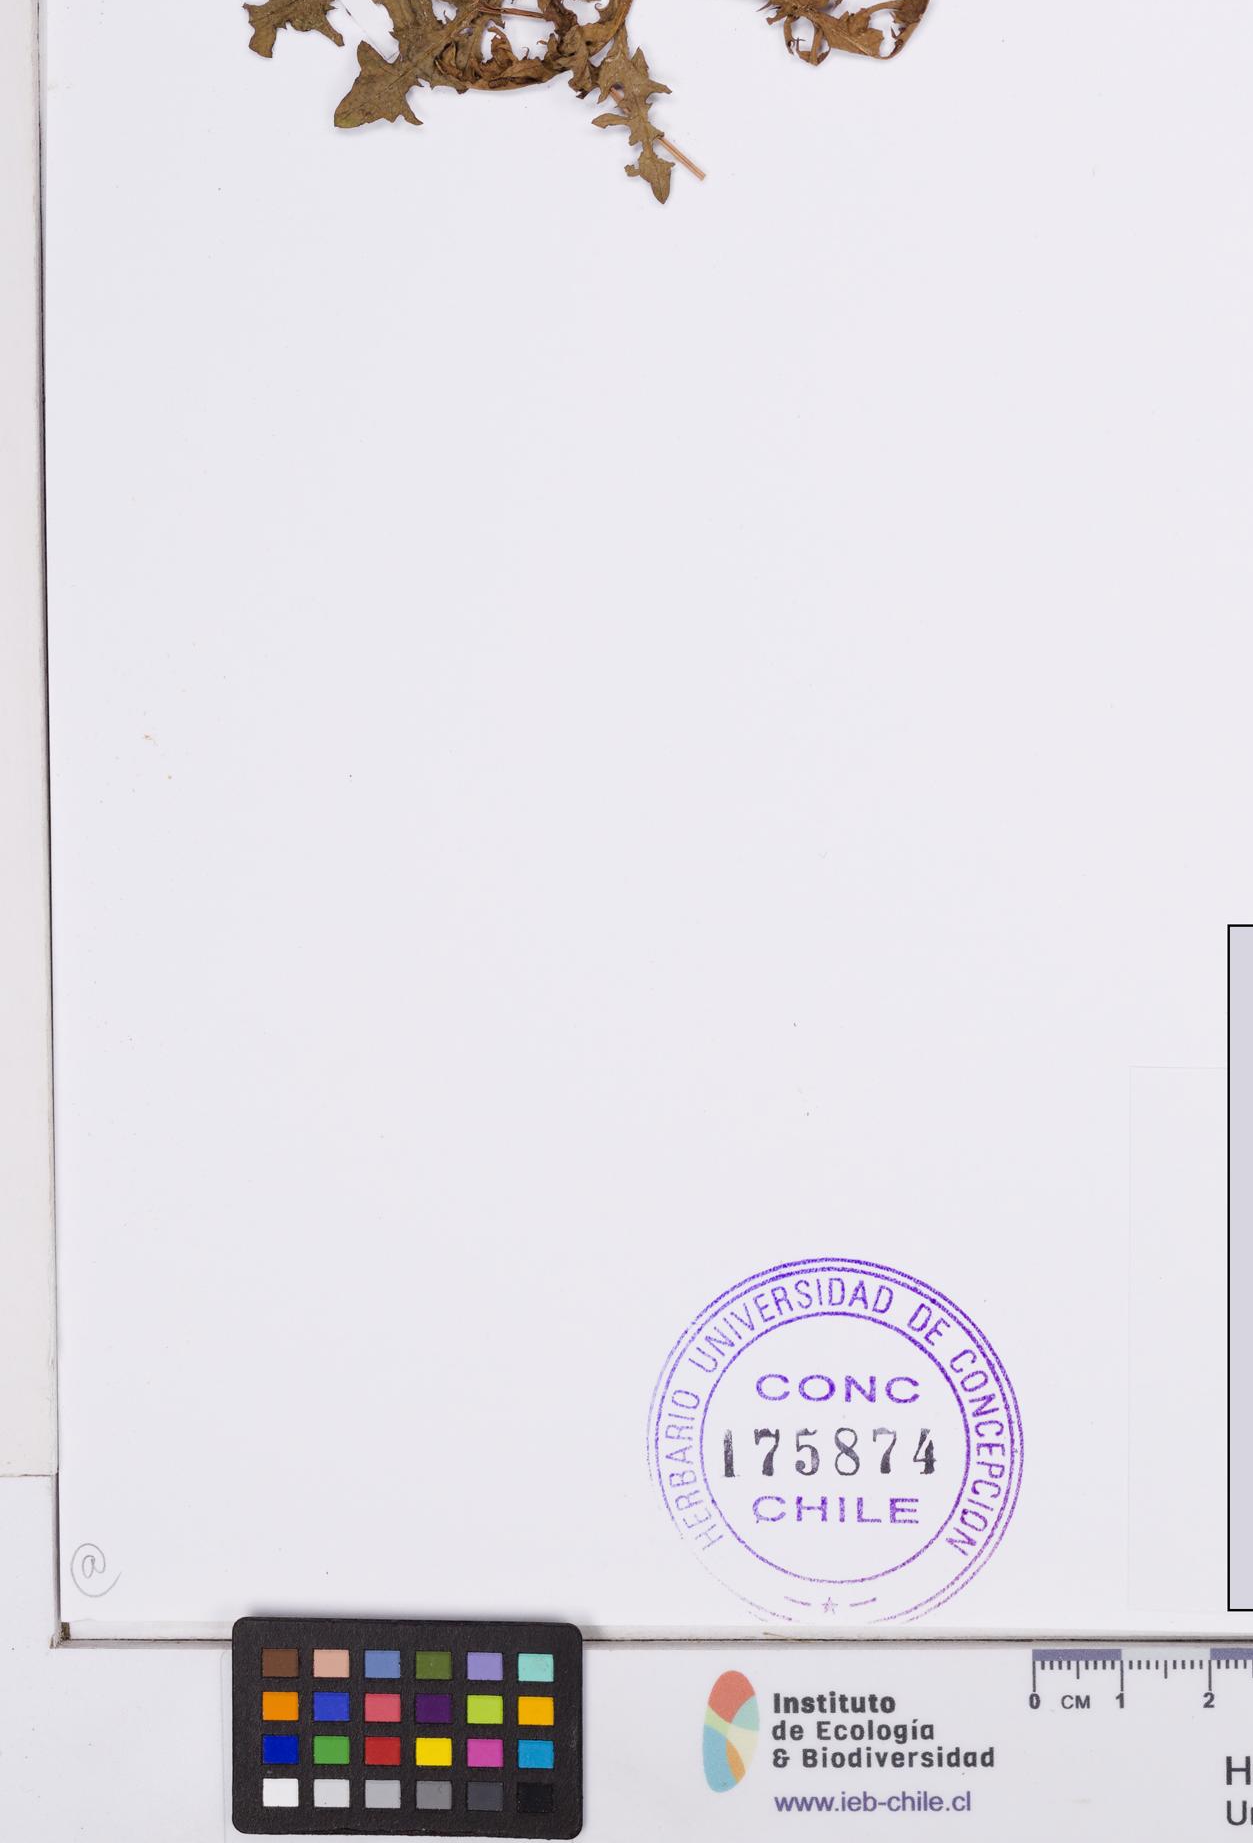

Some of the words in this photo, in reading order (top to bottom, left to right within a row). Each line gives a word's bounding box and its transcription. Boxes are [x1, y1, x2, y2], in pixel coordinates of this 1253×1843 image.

[688, 1277, 894, 1374] UNIVERSIDAD
[907, 1302, 950, 1346] DE
[755, 1374, 921, 1404] CONC
[720, 1427, 937, 1478] 175874
[946, 1349, 1007, 1556] CONCEPCION
[664, 1388, 725, 1551] HERBARIO
[752, 1495, 920, 1524] CHILE
[773, 1691, 897, 1714] Instituto
[1029, 1693, 1041, 1710] 0
[1060, 1694, 1091, 1710] CM
[1115, 1693, 1126, 1709] 1
[1203, 1692, 1215, 1708] 2
[772, 1720, 804, 1741] de
[816, 1719, 935, 1744] Ecología
[772, 1748, 790, 1769] &
[802, 1746, 995, 1769] Biodiversidad
[774, 1790, 972, 1813] www.ieb-chile.cl
